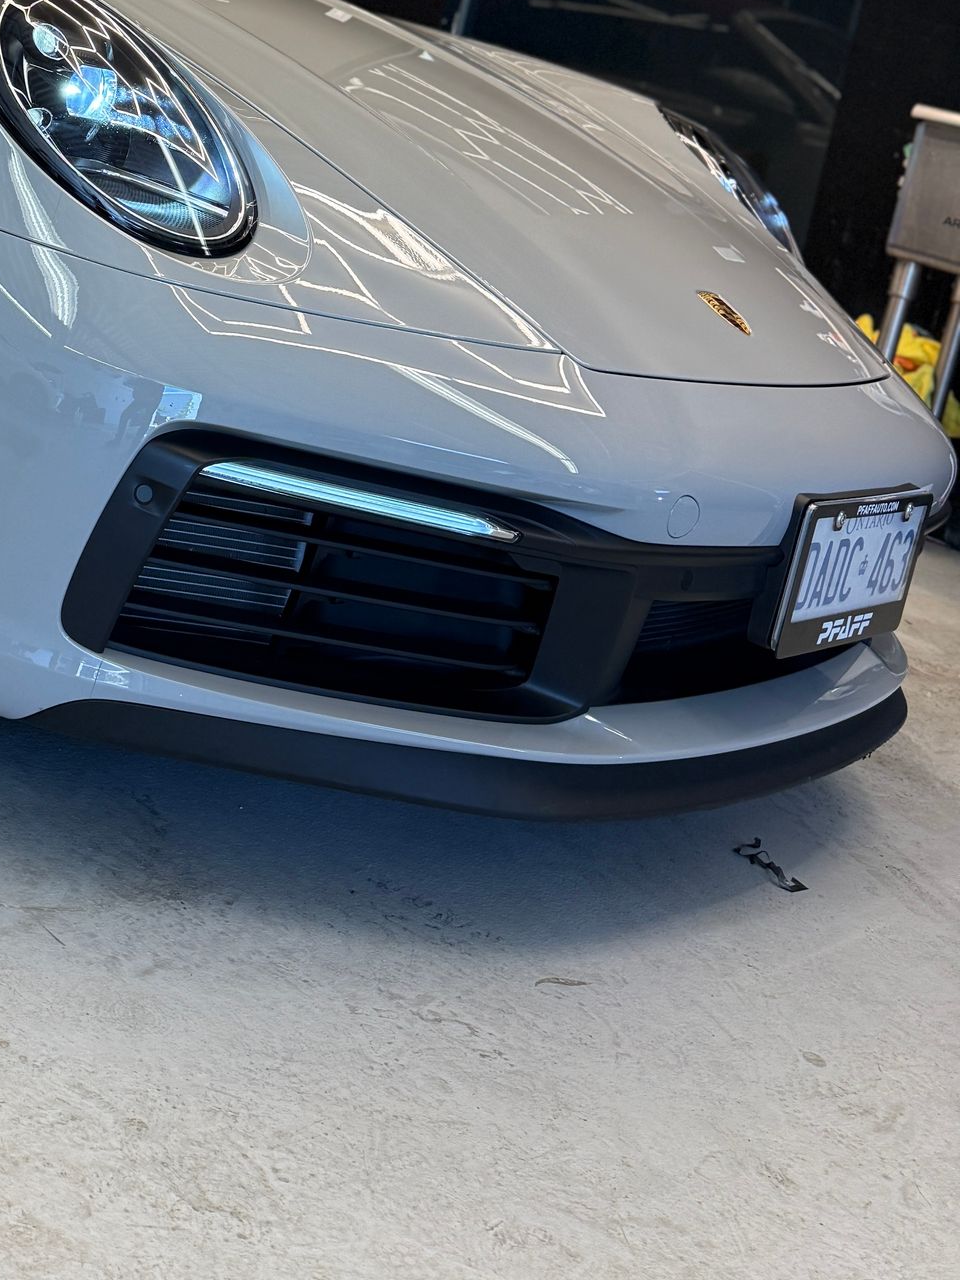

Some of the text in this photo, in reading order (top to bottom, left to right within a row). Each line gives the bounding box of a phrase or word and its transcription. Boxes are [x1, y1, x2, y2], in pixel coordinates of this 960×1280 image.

[856, 501, 900, 516] PFAFFAUTO.COM
[866, 529, 915, 596] 463
[816, 612, 874, 646] PFAFF
